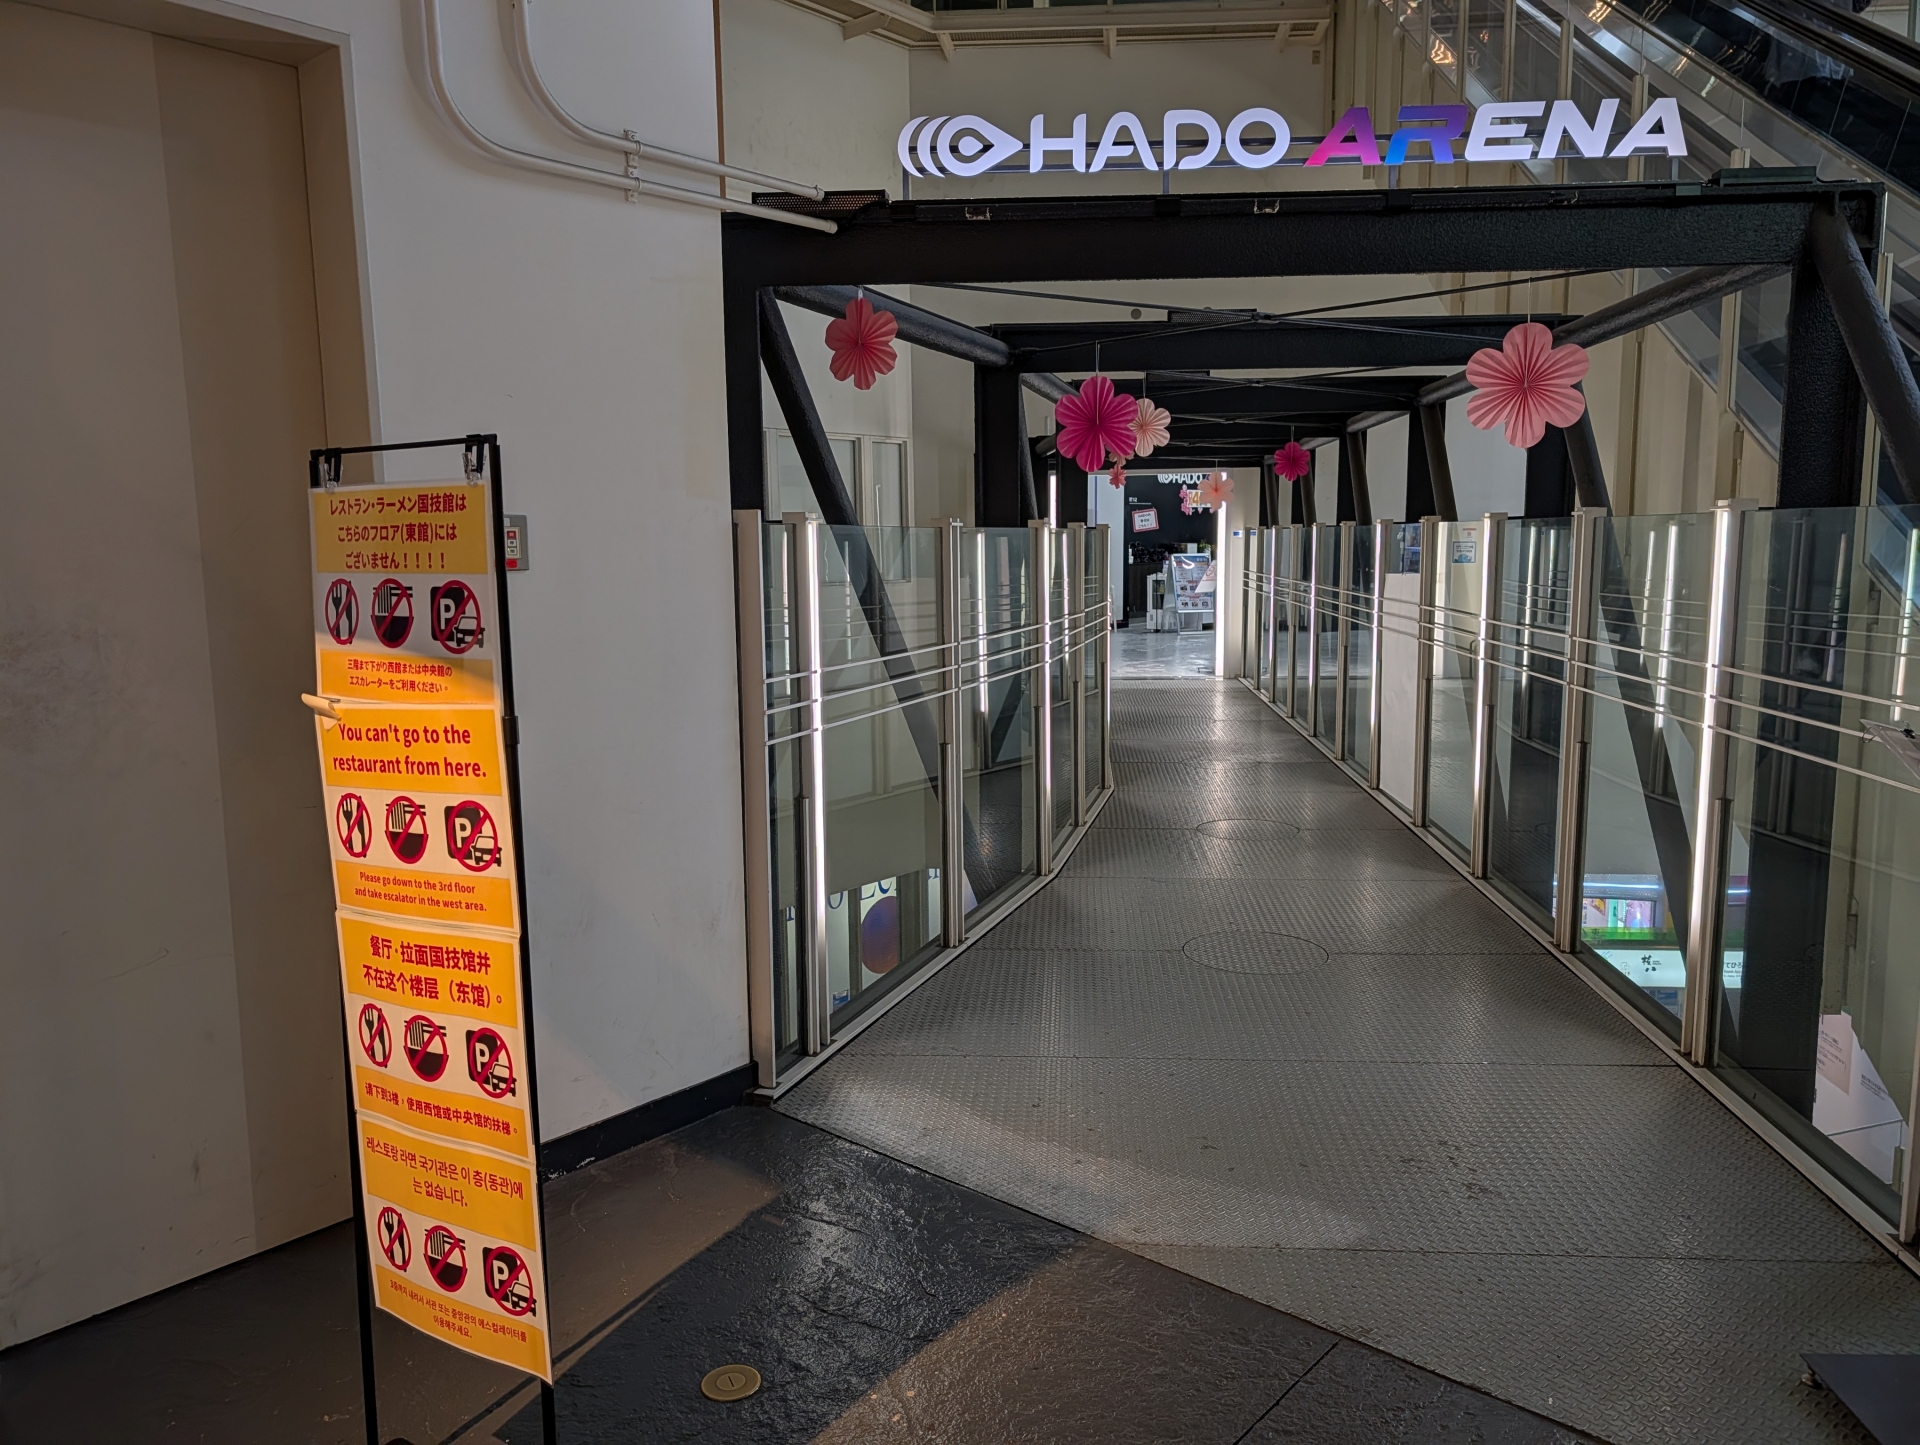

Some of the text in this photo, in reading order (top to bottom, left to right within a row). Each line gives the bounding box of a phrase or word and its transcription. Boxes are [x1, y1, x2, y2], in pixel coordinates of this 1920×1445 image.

[1029, 97, 1687, 172] HADO ARENA
[338, 723, 471, 748] You can't go to the
[333, 755, 487, 778] restaurant from here.
[359, 871, 476, 894] Please go down to the 3rd floor
[354, 887, 487, 911] and take escalator in the west area.
[366, 1136, 398, 1162] 레스토랑
[399, 1149, 418, 1170] 라면
[418, 1155, 459, 1181] 국기관은
[460, 1167, 471, 1185] 이
[412, 1177, 468, 1207] 는 없습니다.
[451, 1307, 477, 1327] 중앙관의
